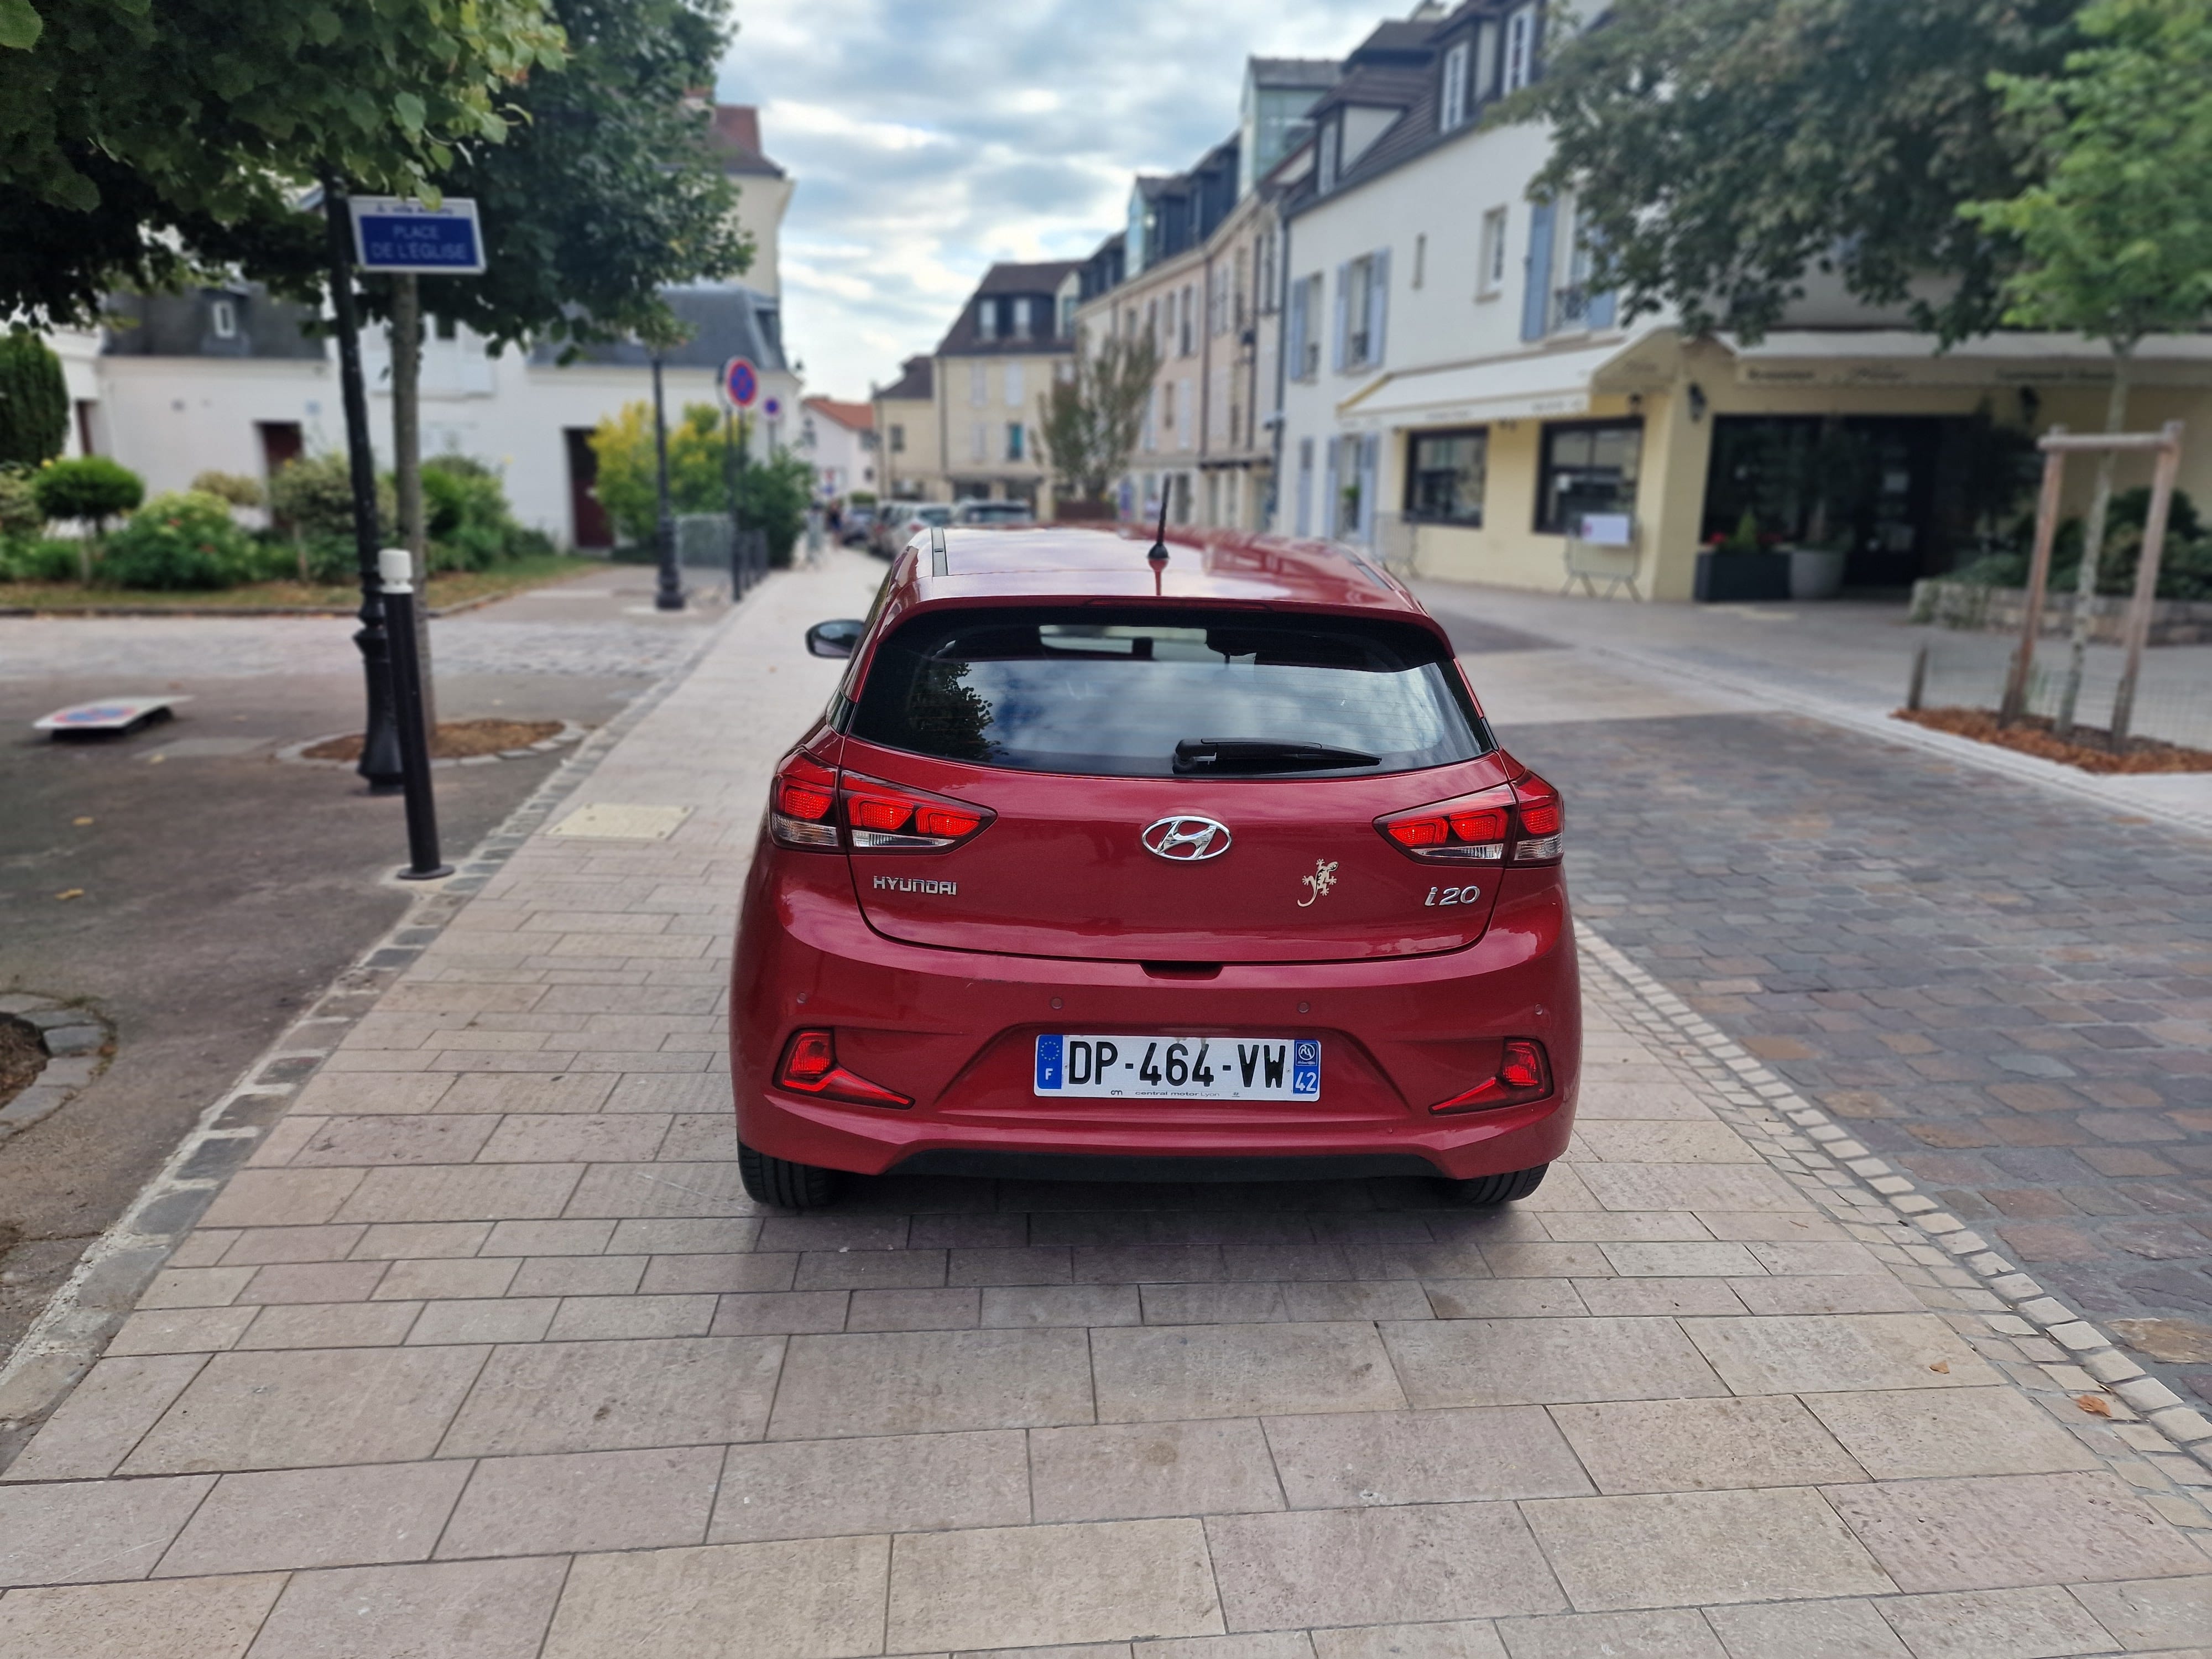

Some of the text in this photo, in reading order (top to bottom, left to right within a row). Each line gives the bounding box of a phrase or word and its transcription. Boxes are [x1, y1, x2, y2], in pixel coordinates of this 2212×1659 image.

[393, 224, 440, 240] PLACE
[371, 242, 393, 259] DE
[873, 875, 957, 895] HYUNDAI
[1425, 886, 1480, 906] i20
[1045, 1068, 1053, 1081] F
[1068, 1041, 1286, 1088] DP-464-VW
[1295, 1072, 1317, 1092] 42
